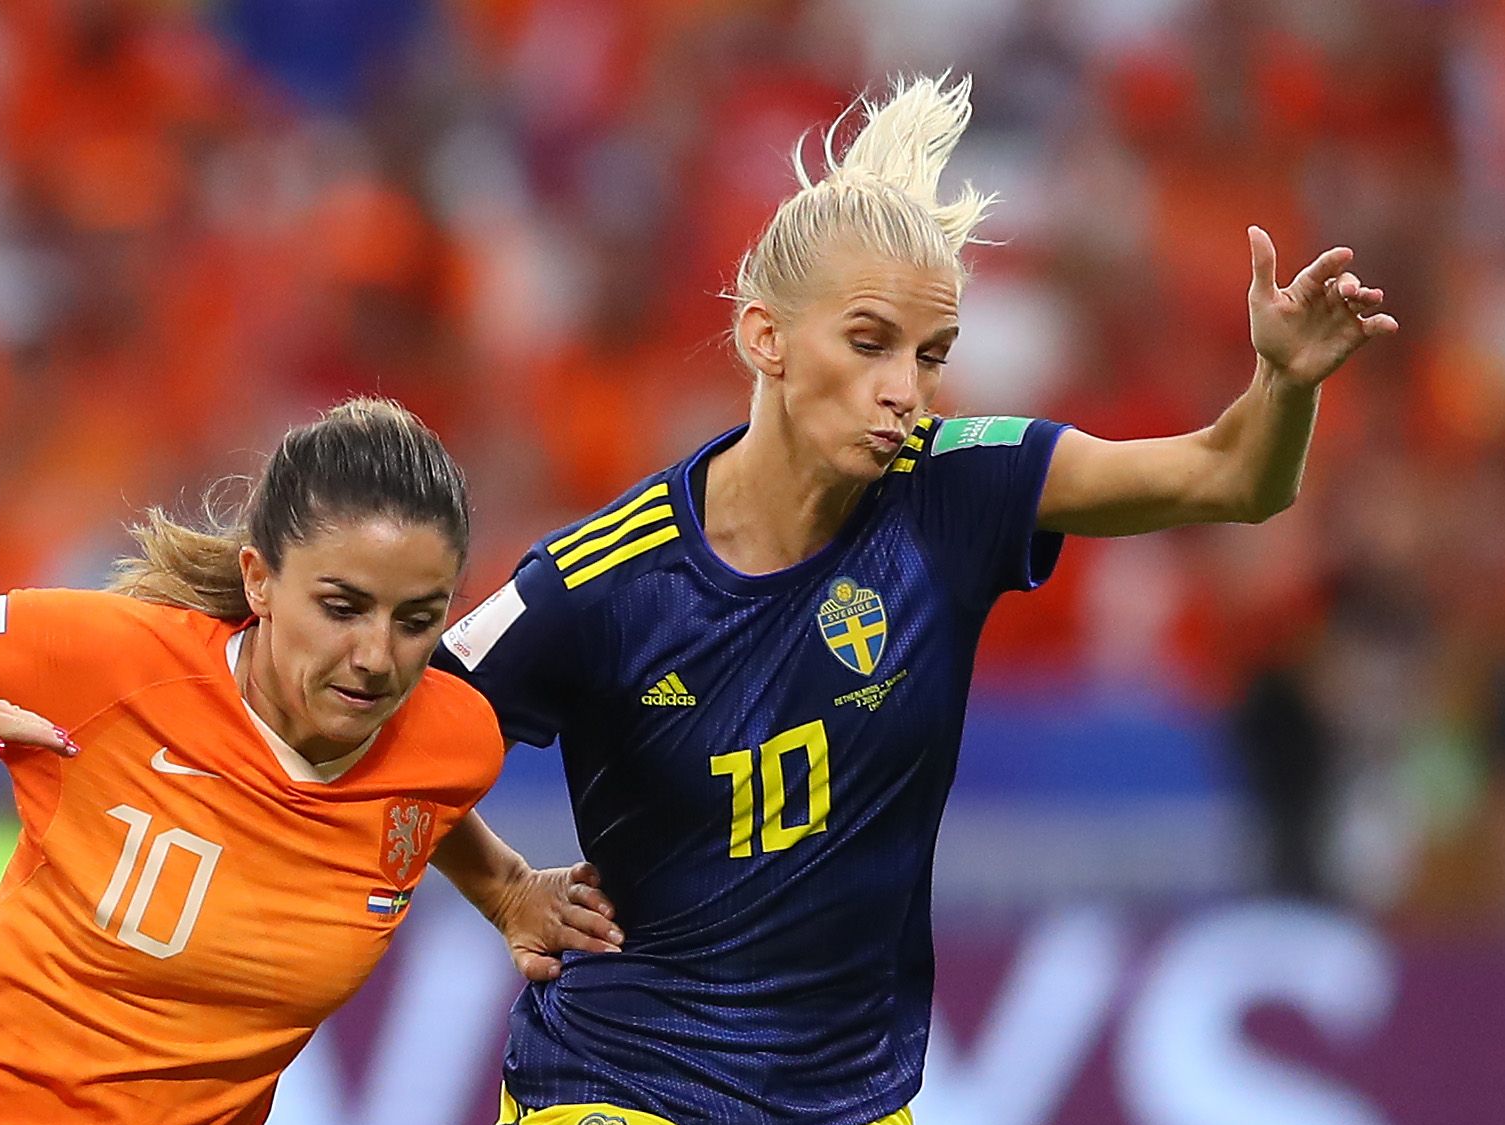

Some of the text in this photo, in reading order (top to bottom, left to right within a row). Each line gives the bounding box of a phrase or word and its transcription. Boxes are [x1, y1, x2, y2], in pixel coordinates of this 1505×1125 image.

[827, 601, 872, 623] SVERIGE
[641, 693, 697, 706] adidas
[710, 719, 831, 858] 10
[93, 804, 224, 959] 10
